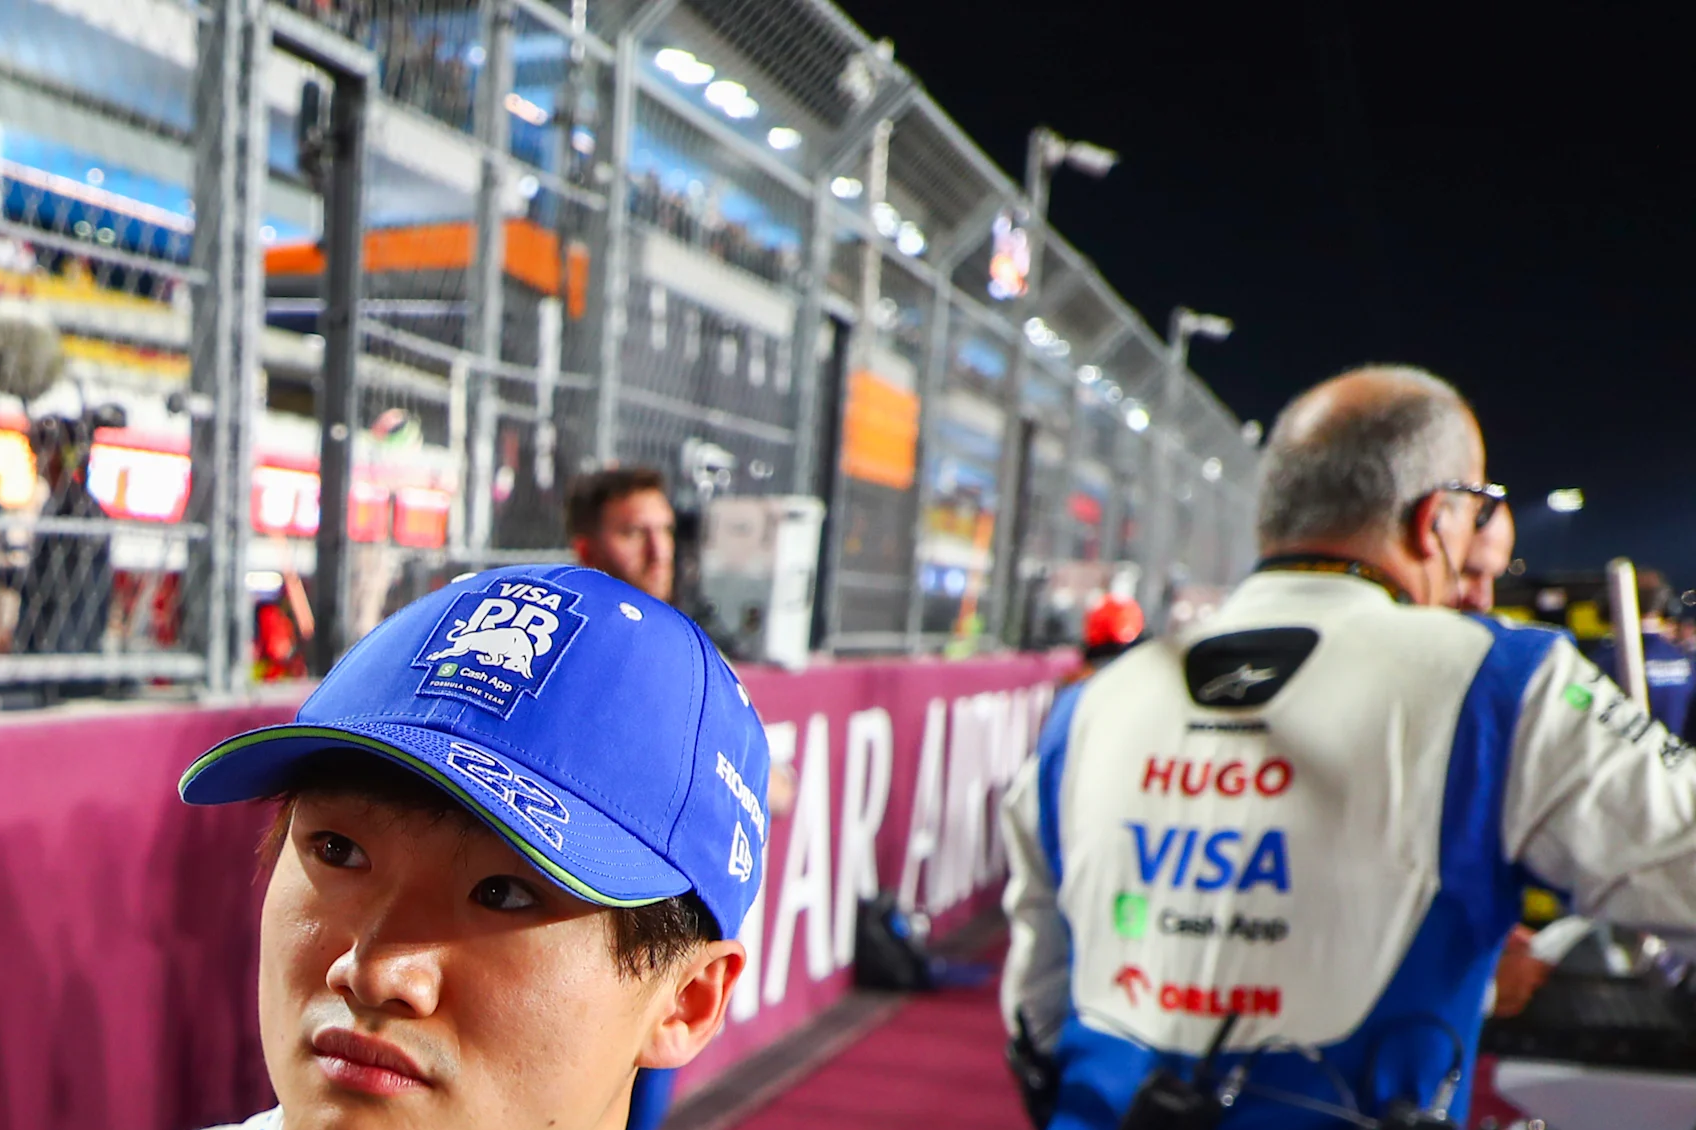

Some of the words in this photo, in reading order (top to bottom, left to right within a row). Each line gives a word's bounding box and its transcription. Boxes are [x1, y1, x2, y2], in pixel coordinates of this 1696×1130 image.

[499, 583, 562, 611] VISA
[429, 680, 464, 691] FORMULA
[465, 685, 483, 696] ONE
[484, 691, 505, 706] TEAM
[459, 667, 488, 682] Cash
[488, 676, 513, 693] App
[1141, 757, 1294, 798] HUGO
[447, 741, 570, 852] 22
[1122, 821, 1292, 894] VISA
